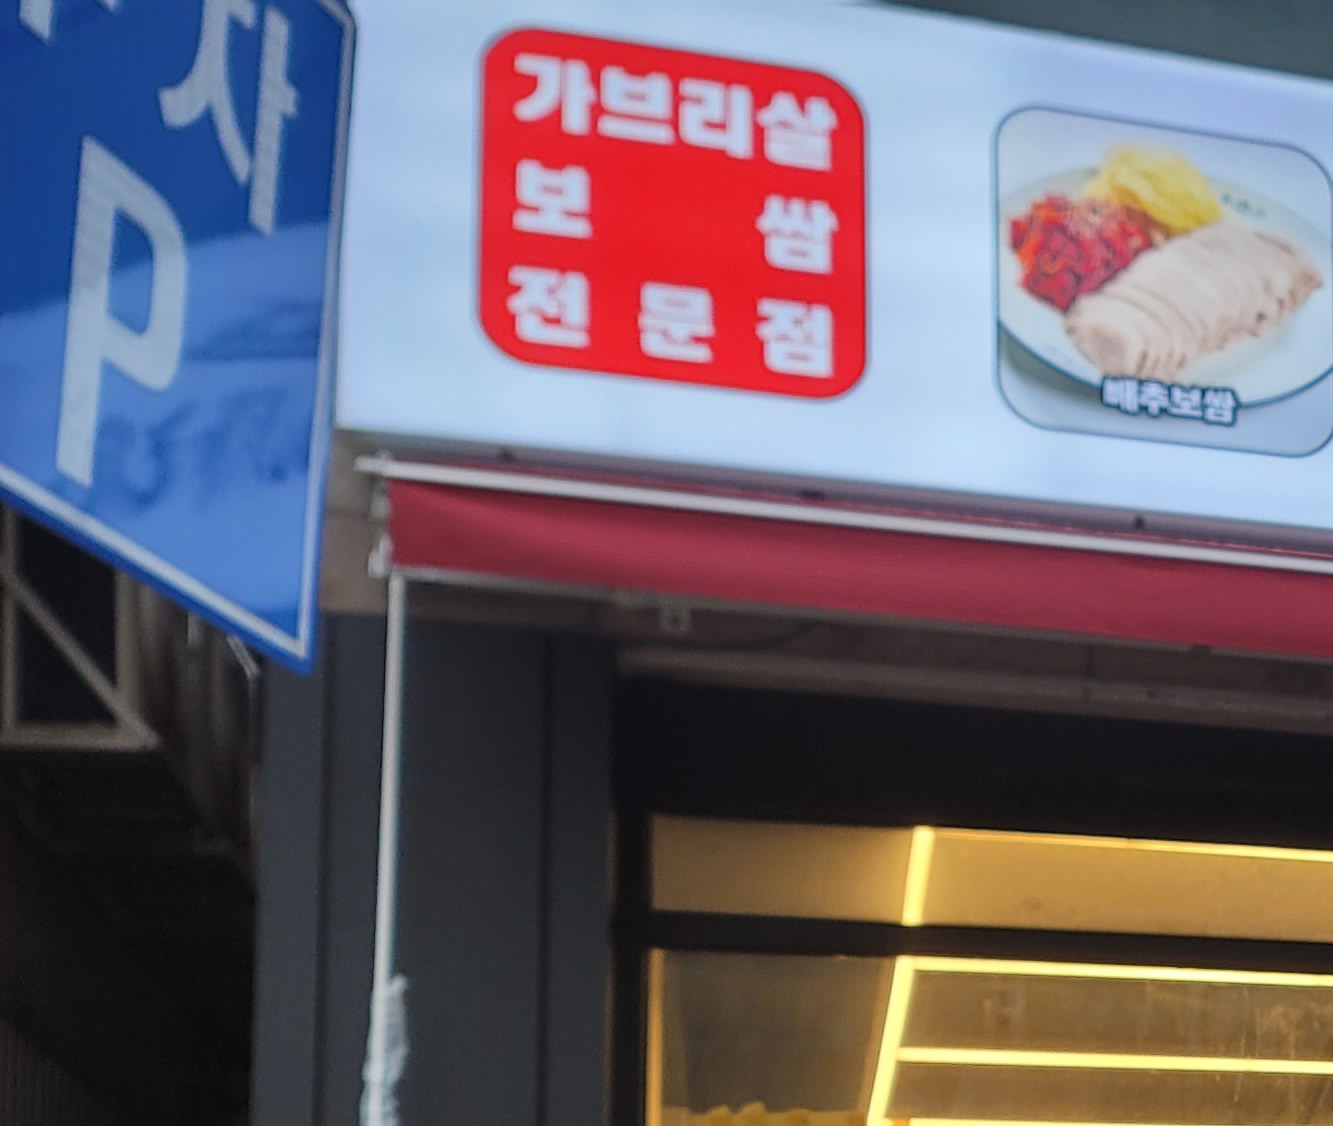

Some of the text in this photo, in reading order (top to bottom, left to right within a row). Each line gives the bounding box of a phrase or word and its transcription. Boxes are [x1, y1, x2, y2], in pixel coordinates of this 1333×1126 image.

[512, 53, 838, 172] 가브리살
[56, 136, 188, 488] P
[507, 267, 834, 379] 전문점
[1102, 376, 1239, 426] 배추보쌈
